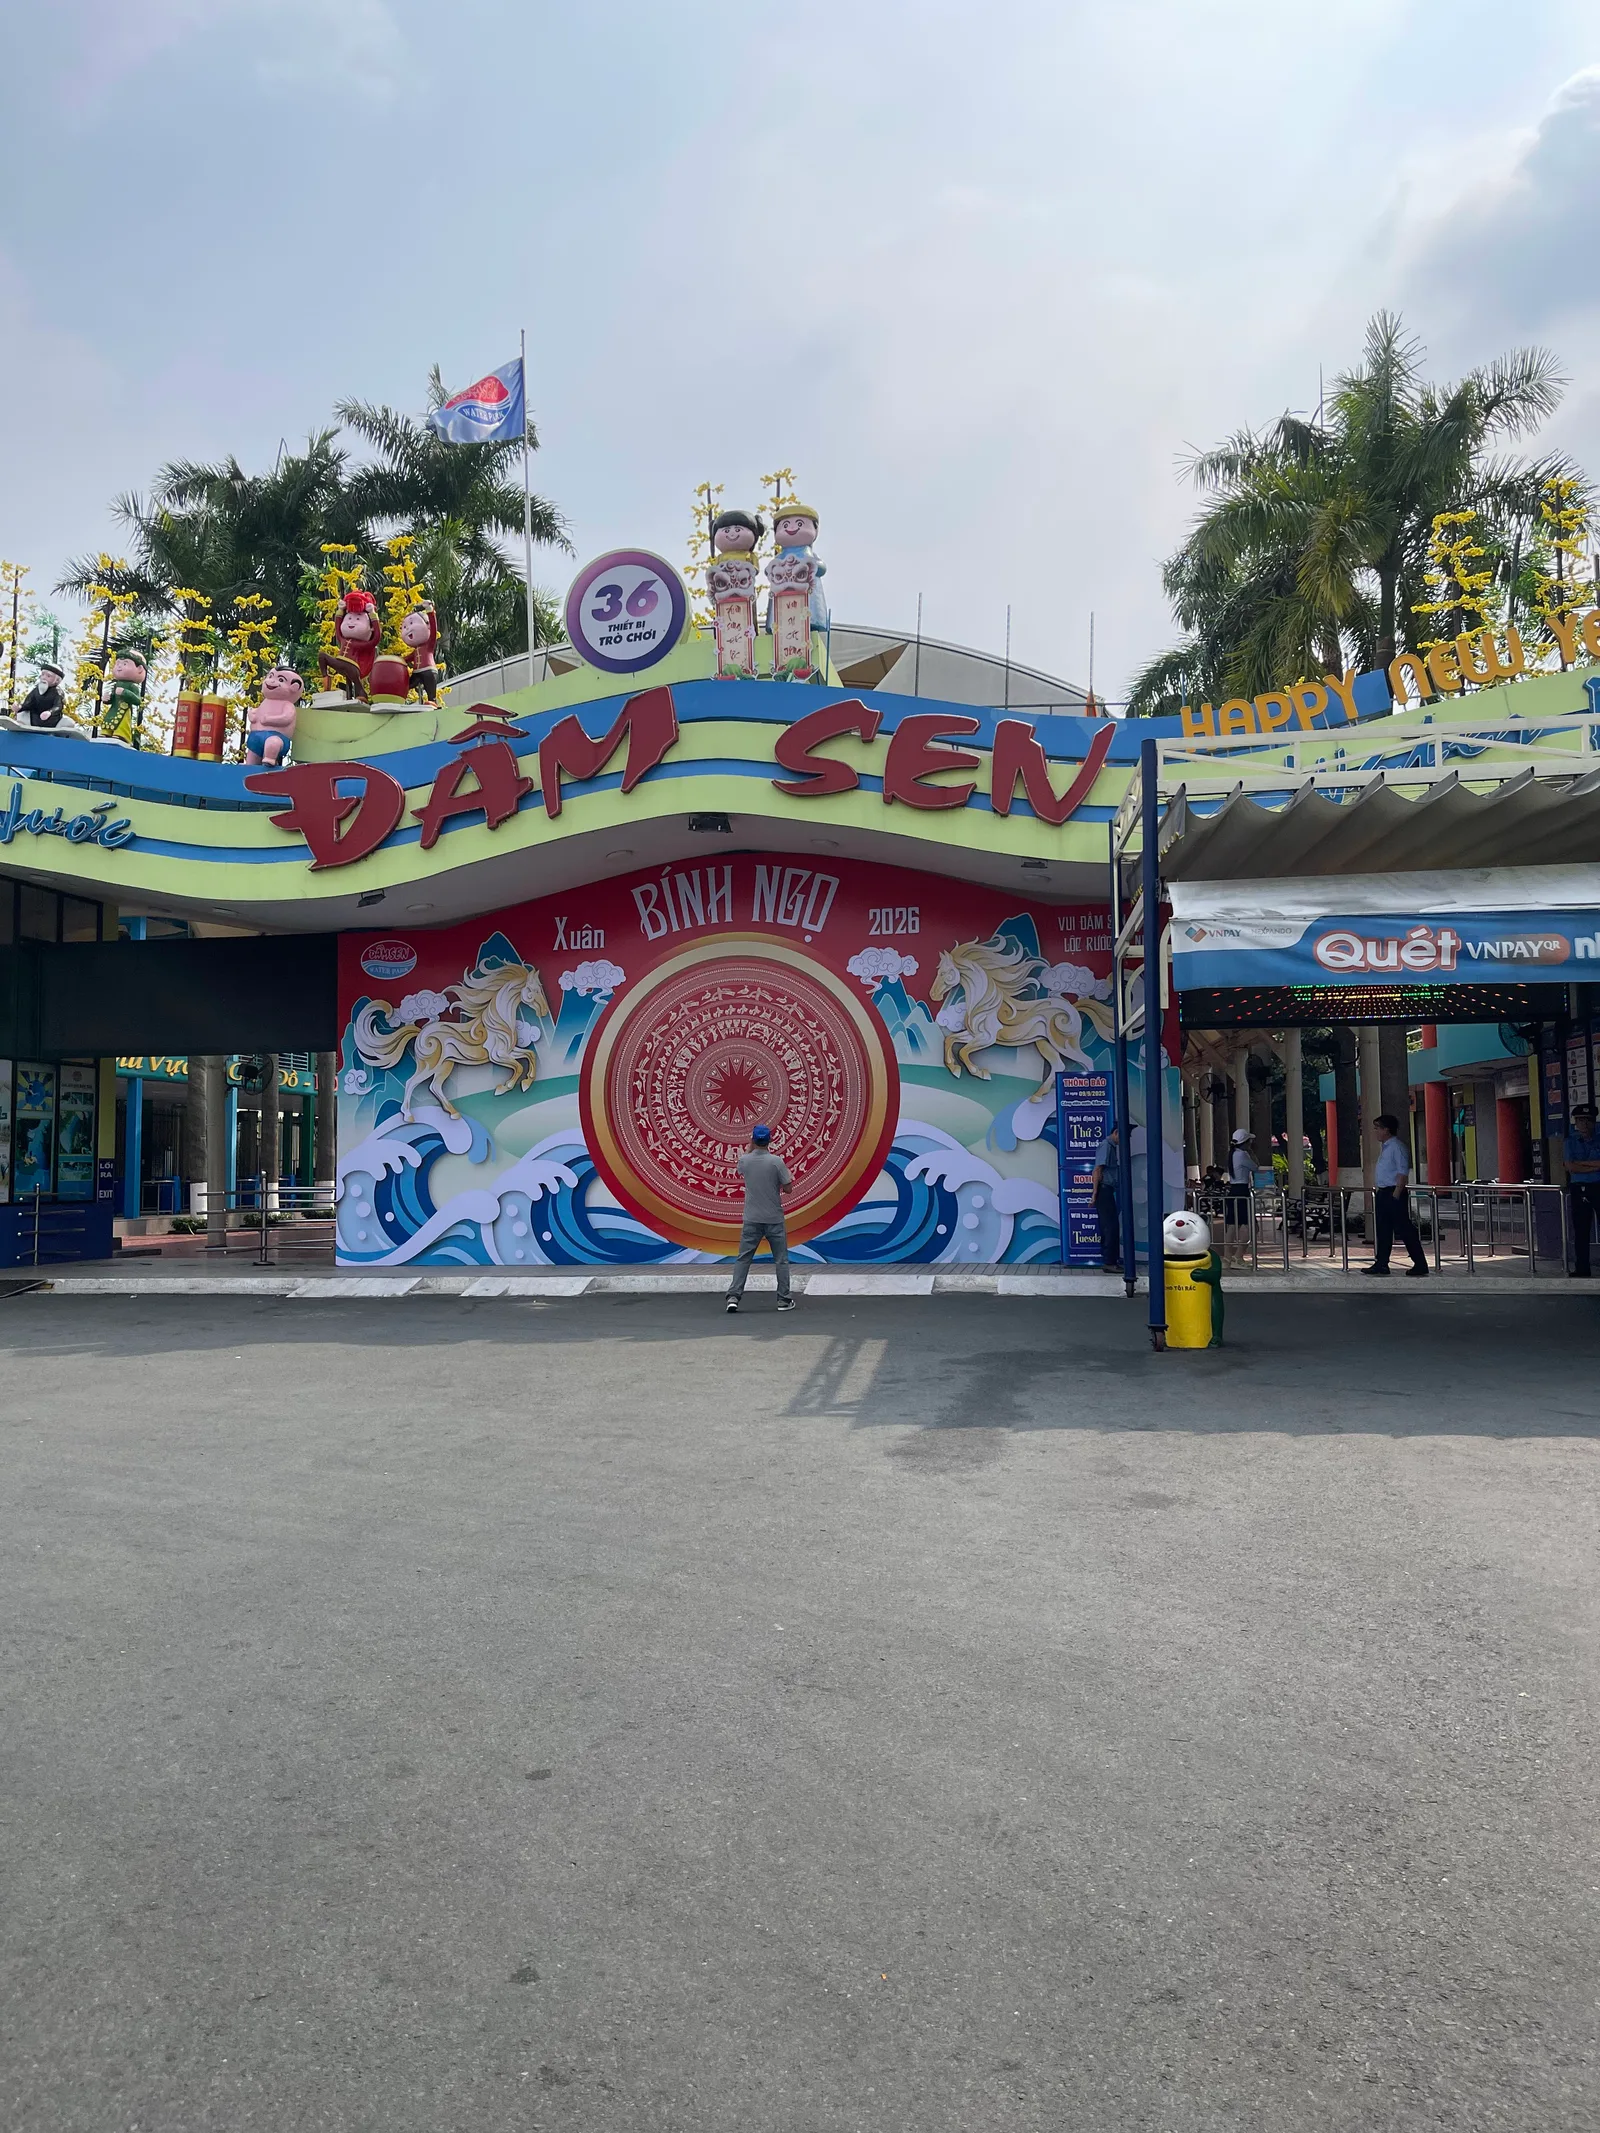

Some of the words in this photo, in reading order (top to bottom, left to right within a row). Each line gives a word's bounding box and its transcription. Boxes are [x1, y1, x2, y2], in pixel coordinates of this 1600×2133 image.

[591, 579, 659, 622] 36
[608, 619, 634, 632] THIẾT
[636, 620, 646, 631] BỊ
[599, 632, 623, 646] TRÒ
[626, 629, 657, 643] CHƠI
[1181, 669, 1359, 752] HAPPY
[244, 684, 680, 872] ĐẦM
[771, 698, 1118, 827] SEN
[630, 865, 733, 942] BÍNH
[751, 865, 840, 944] NGỌ
[868, 906, 921, 935] 2026
[1058, 916, 1076, 931] VUI
[553, 916, 605, 951] Xuân
[1208, 929, 1242, 938] VNPAY
[1063, 934, 1081, 955] LỘC
[1315, 926, 1457, 969] Quét
[1062, 1077, 1090, 1088] THÔNG
[1090, 1076, 1107, 1087] BÁO
[1070, 1124, 1092, 1140] Thứ
[1094, 1125, 1102, 1138] 3
[99, 1160, 114, 1169] LỐI
[99, 1189, 114, 1199] EXIT
[1072, 1230, 1102, 1245] Tuesda
